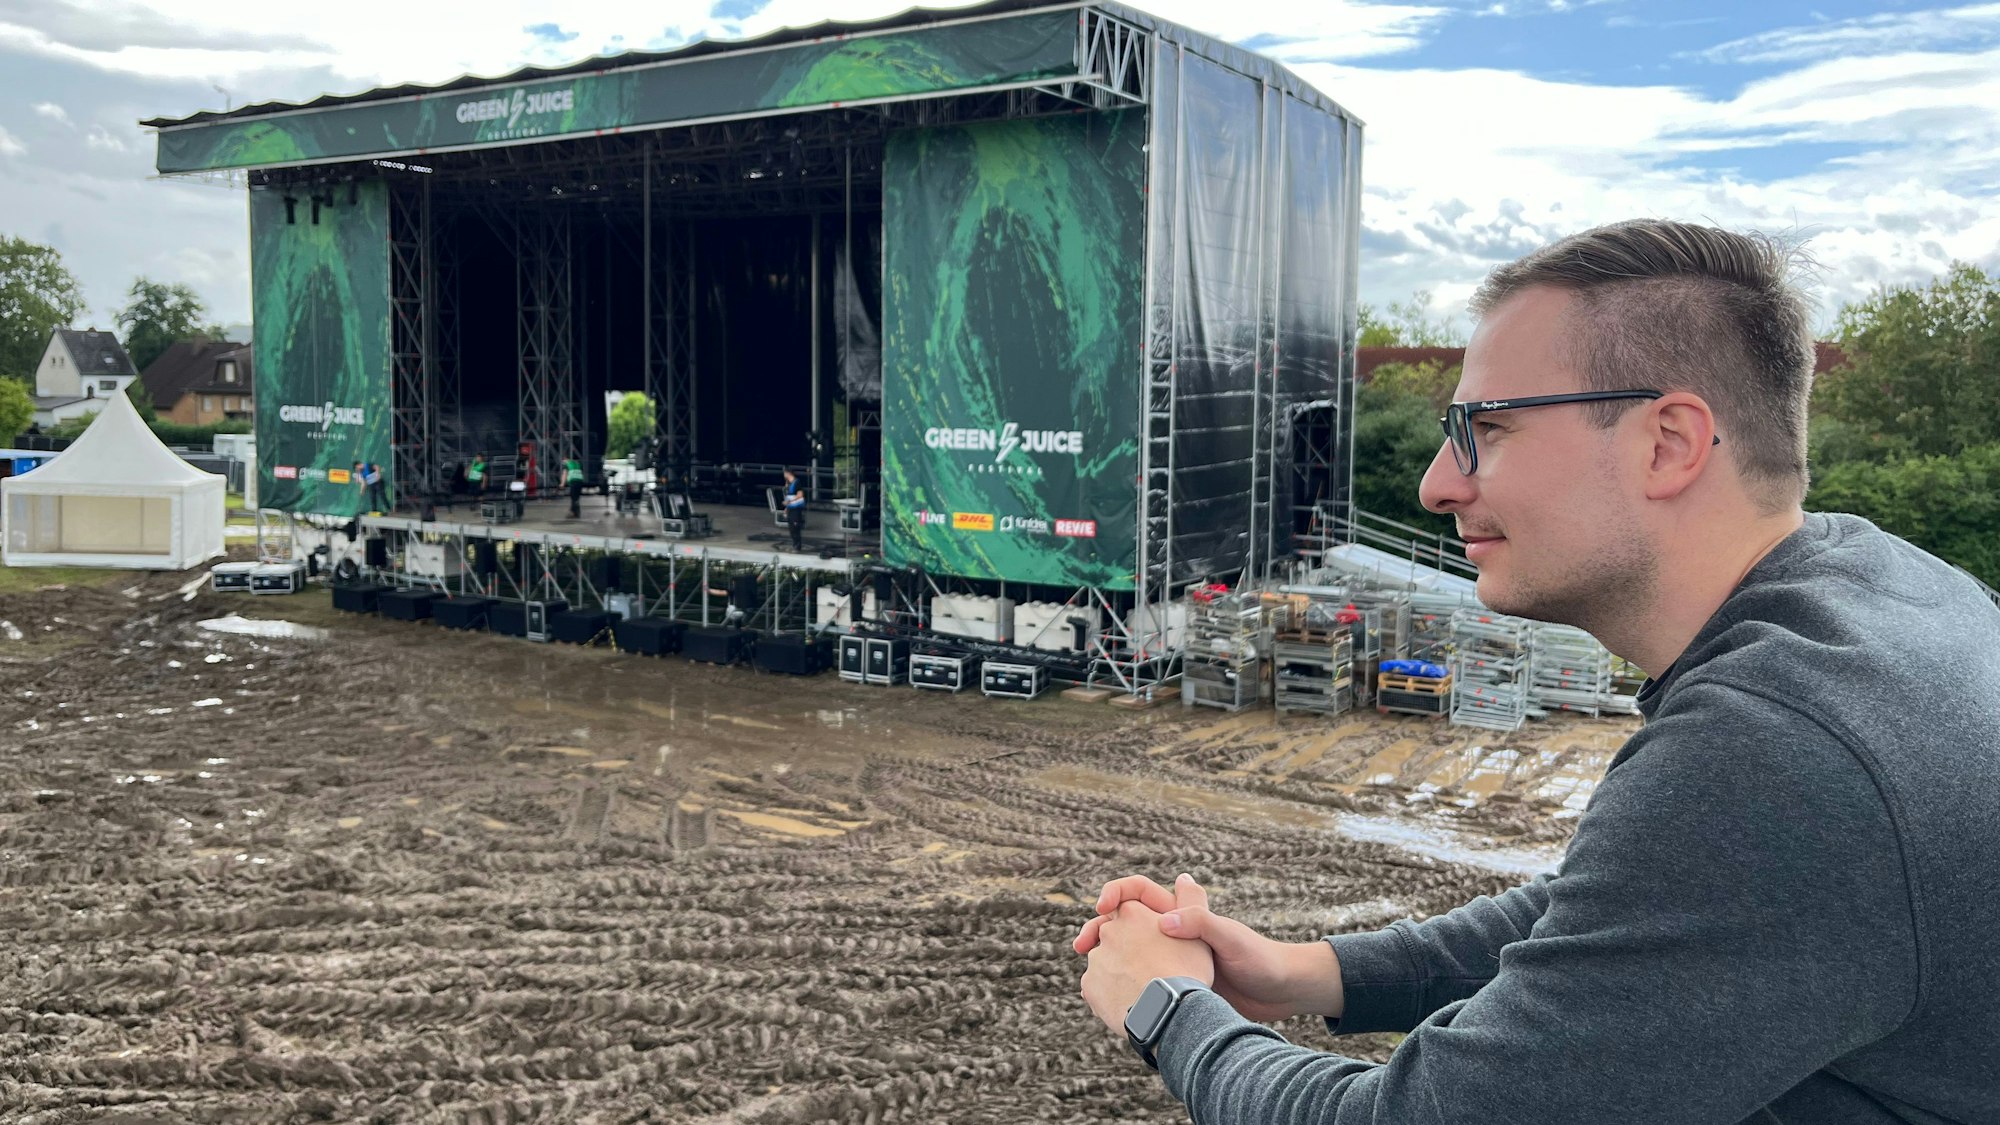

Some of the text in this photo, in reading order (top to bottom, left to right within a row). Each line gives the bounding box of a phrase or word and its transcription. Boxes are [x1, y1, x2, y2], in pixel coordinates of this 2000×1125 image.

[456, 89, 574, 123] GREEN JUICE
[280, 405, 364, 425] GREEN JUICE
[925, 427, 1084, 453] GREEN JUICE
[968, 464, 1043, 475] FESTIVAL
[960, 514, 987, 523] DHL
[1057, 520, 1094, 534] REWE
